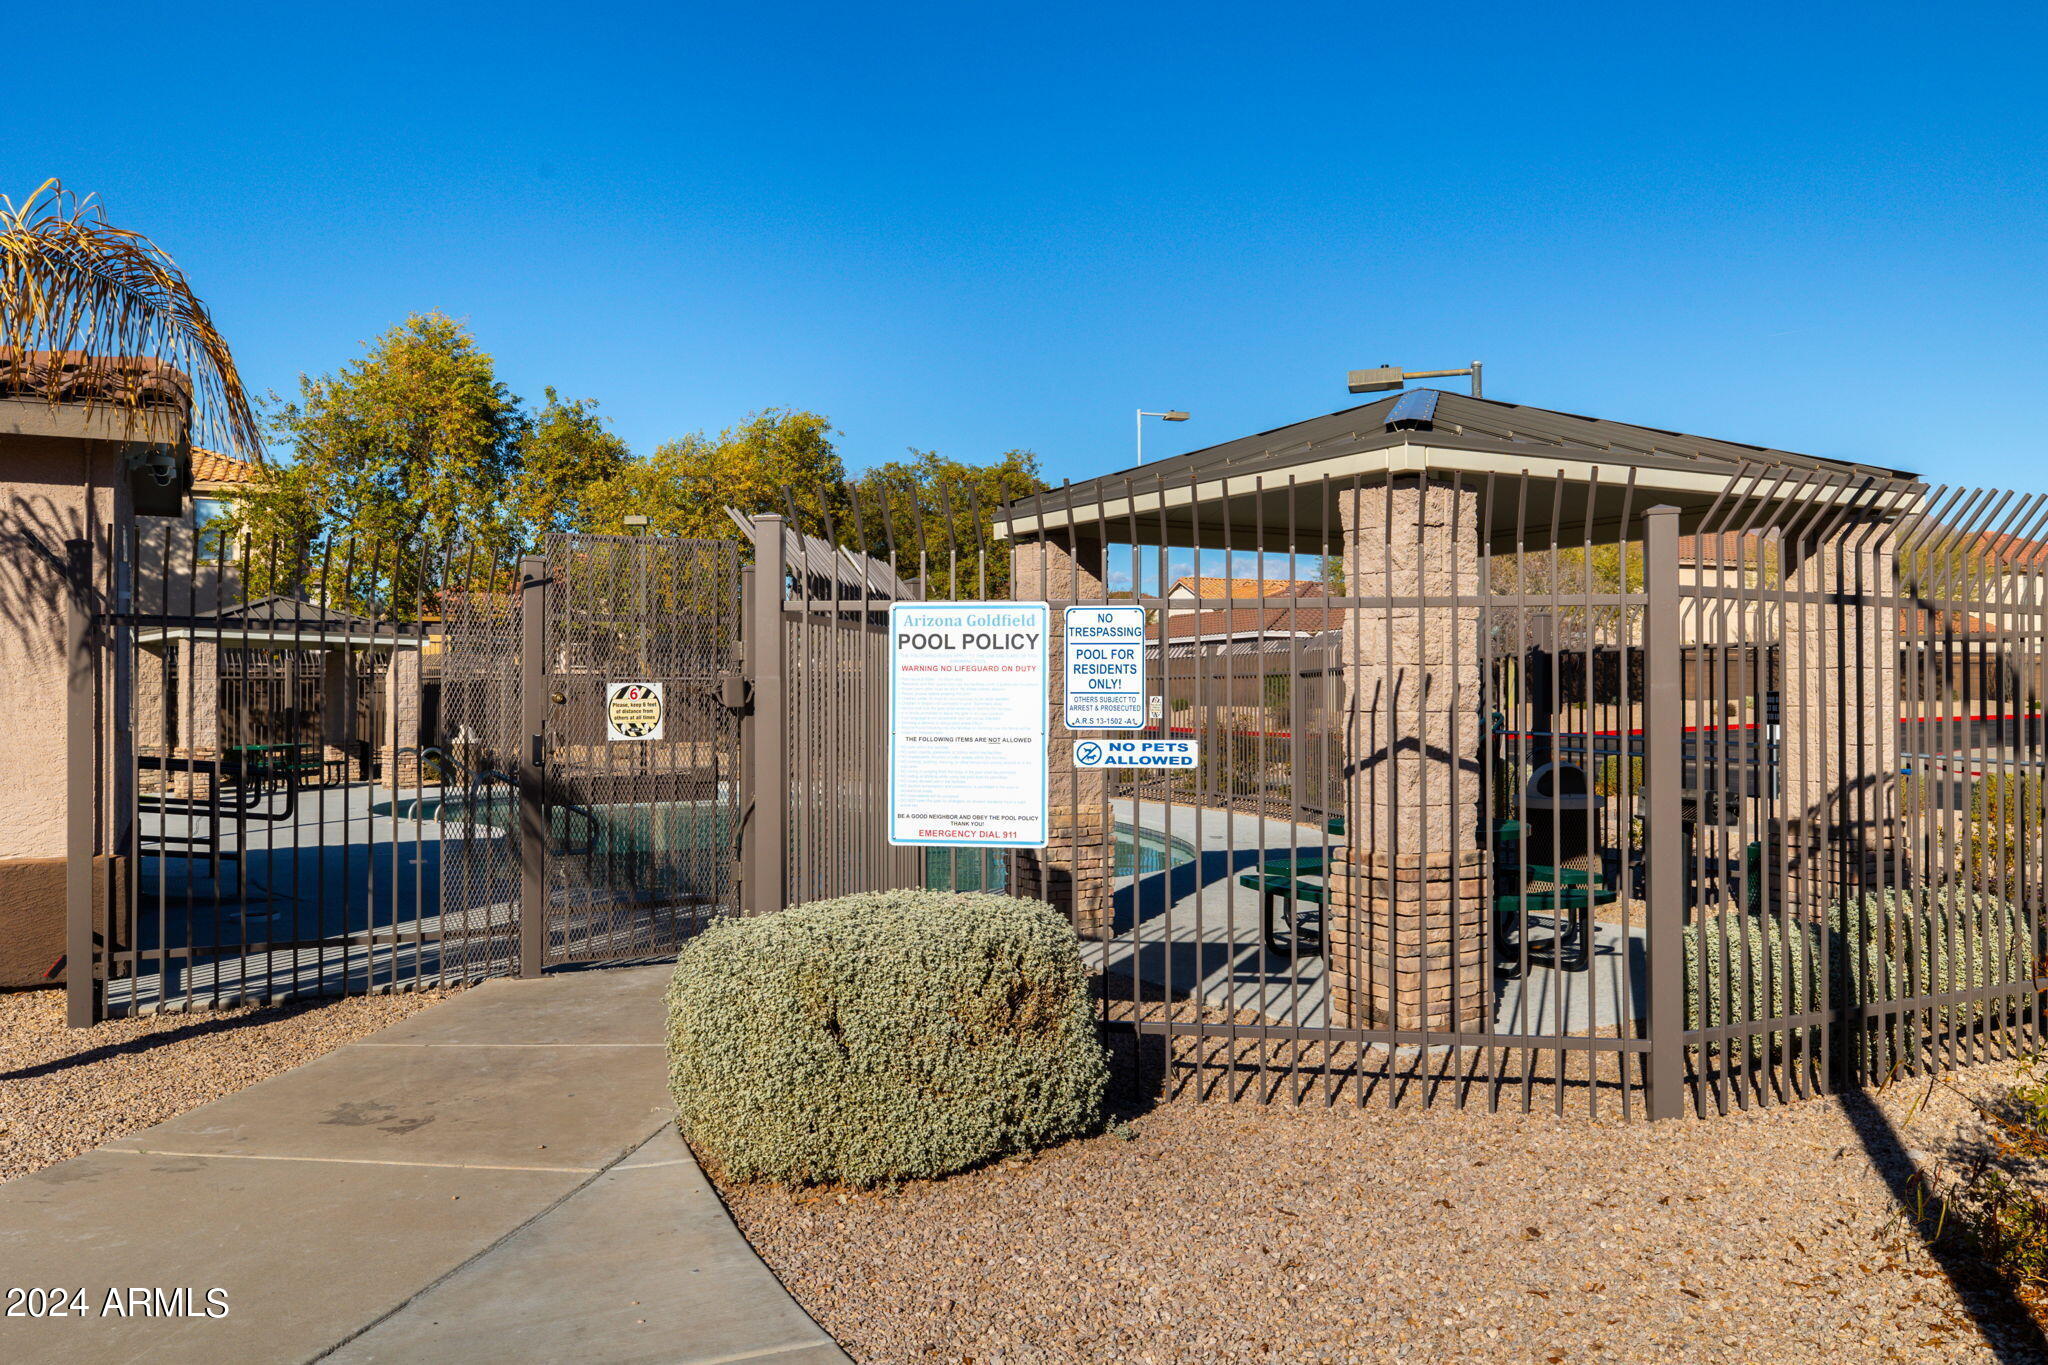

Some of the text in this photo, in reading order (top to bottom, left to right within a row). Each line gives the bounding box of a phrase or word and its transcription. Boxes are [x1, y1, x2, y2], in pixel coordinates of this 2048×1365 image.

[904, 614, 1035, 627] Arizona Goldfield
[1097, 613, 1113, 623] NO
[1069, 627, 1142, 637] TRESPASSING
[898, 633, 1040, 650] POOL POLICY
[1076, 649, 1134, 660] POOL FOR
[1074, 664, 1137, 674] RESIDENTS
[1088, 679, 1122, 689] ONLY!
[1109, 743, 1189, 752] NO PETS
[1105, 756, 1193, 765] ALLOWED
[919, 829, 1017, 839] EMERGENCY DIAL 911
